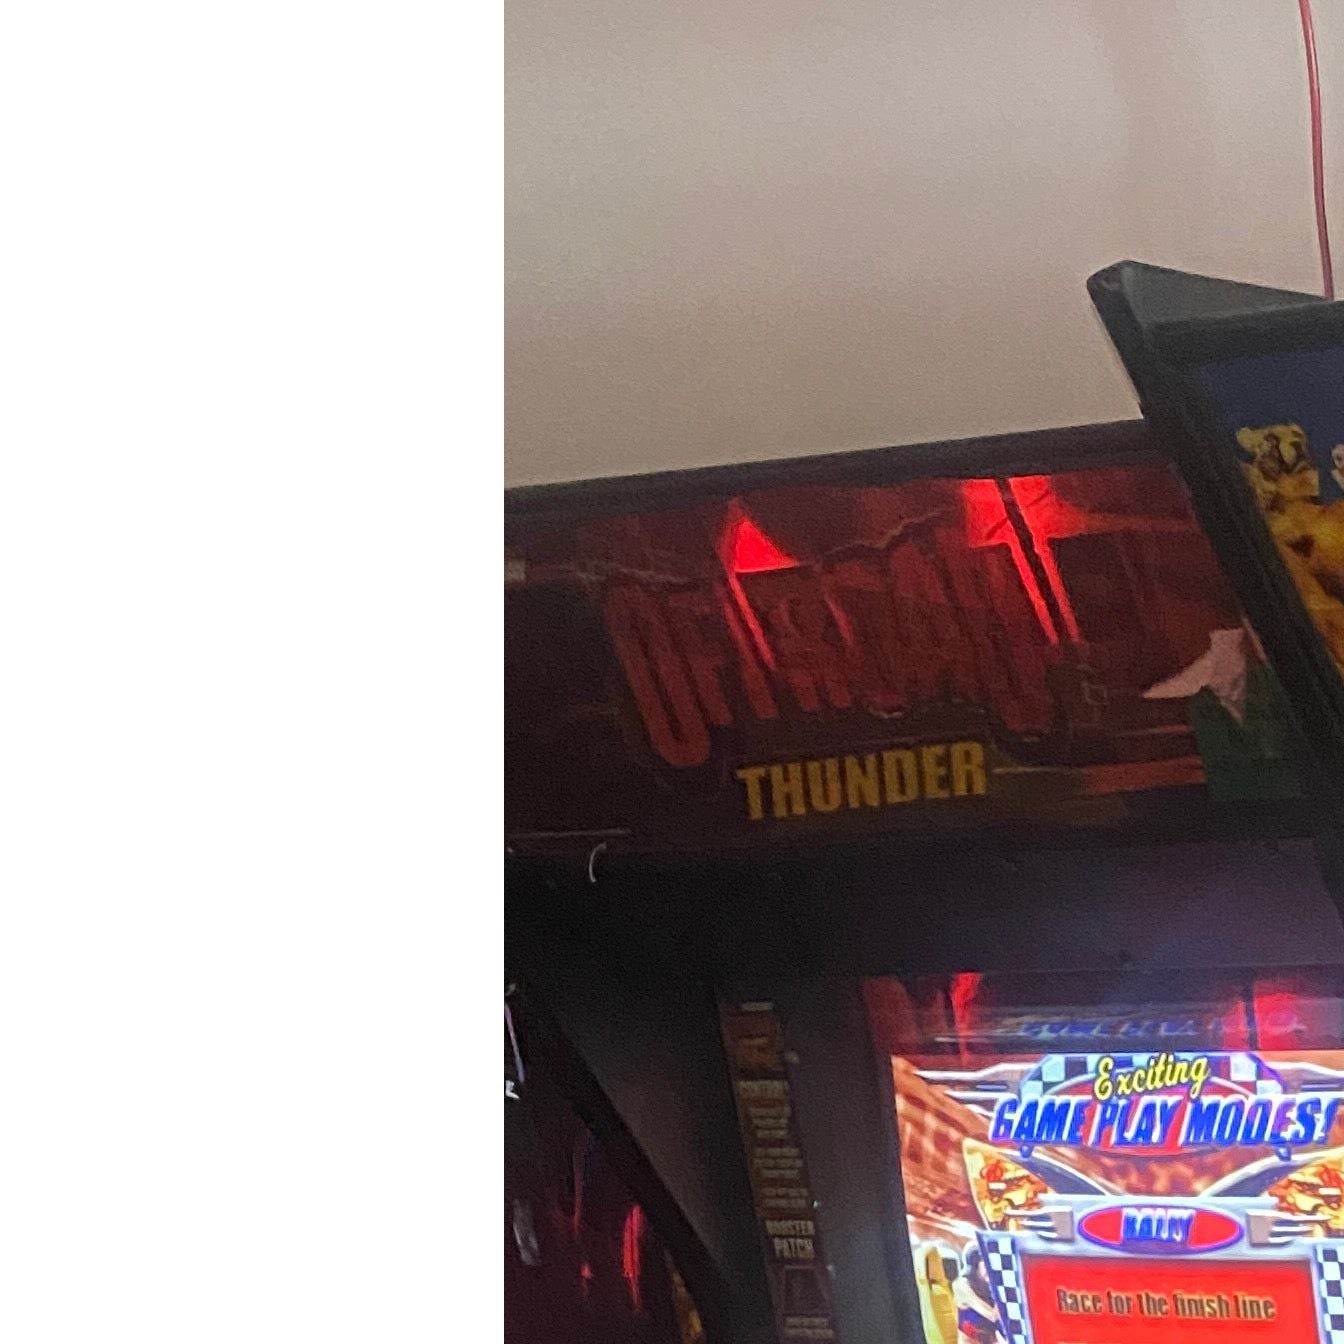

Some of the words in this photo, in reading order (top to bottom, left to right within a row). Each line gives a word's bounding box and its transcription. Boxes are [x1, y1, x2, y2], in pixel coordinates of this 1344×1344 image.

[736, 740, 987, 821] THUNDER
[1094, 1053, 1211, 1100] Exciting
[991, 1097, 1093, 1144] GAME
[1094, 1098, 1186, 1147] PLAY
[1186, 1097, 1339, 1148] MODES!
[1056, 1288, 1102, 1314] Race
[1107, 1290, 1132, 1314] for
[1137, 1291, 1169, 1316] the
[1172, 1292, 1231, 1318] finish
[1234, 1294, 1276, 1320] line
